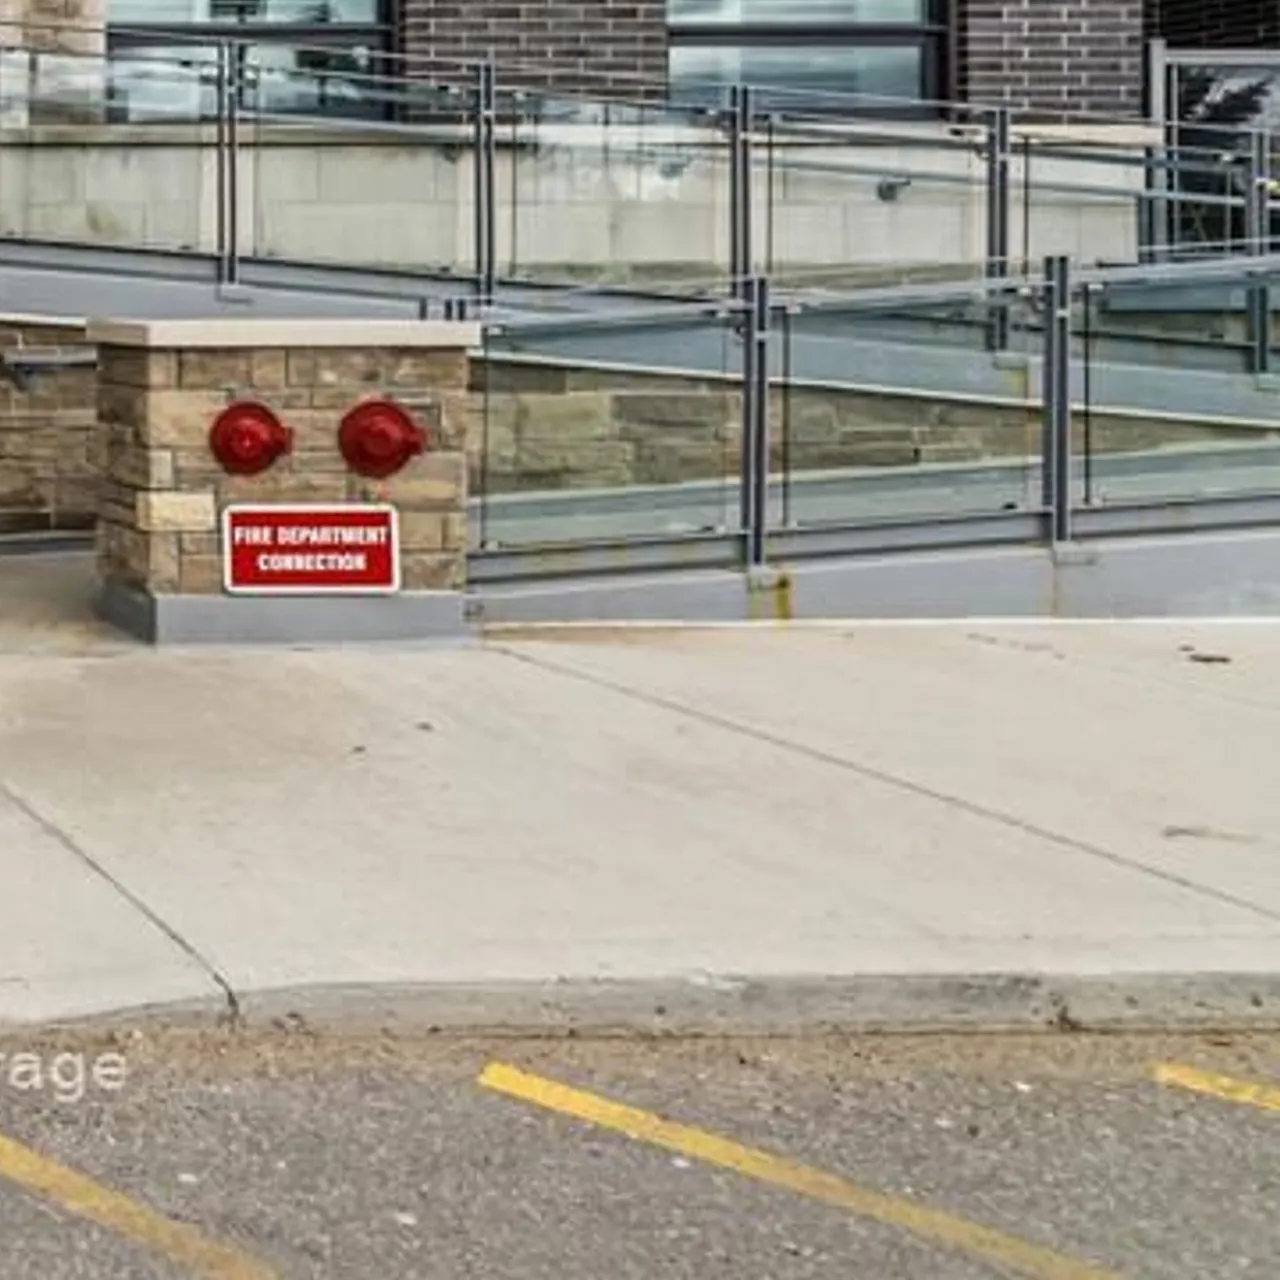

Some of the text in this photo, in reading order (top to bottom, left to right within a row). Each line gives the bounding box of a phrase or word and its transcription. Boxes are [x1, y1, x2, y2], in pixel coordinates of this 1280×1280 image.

[234, 526, 388, 544] FIRE DEPARTMENT
[257, 554, 366, 571] CONNECTION
